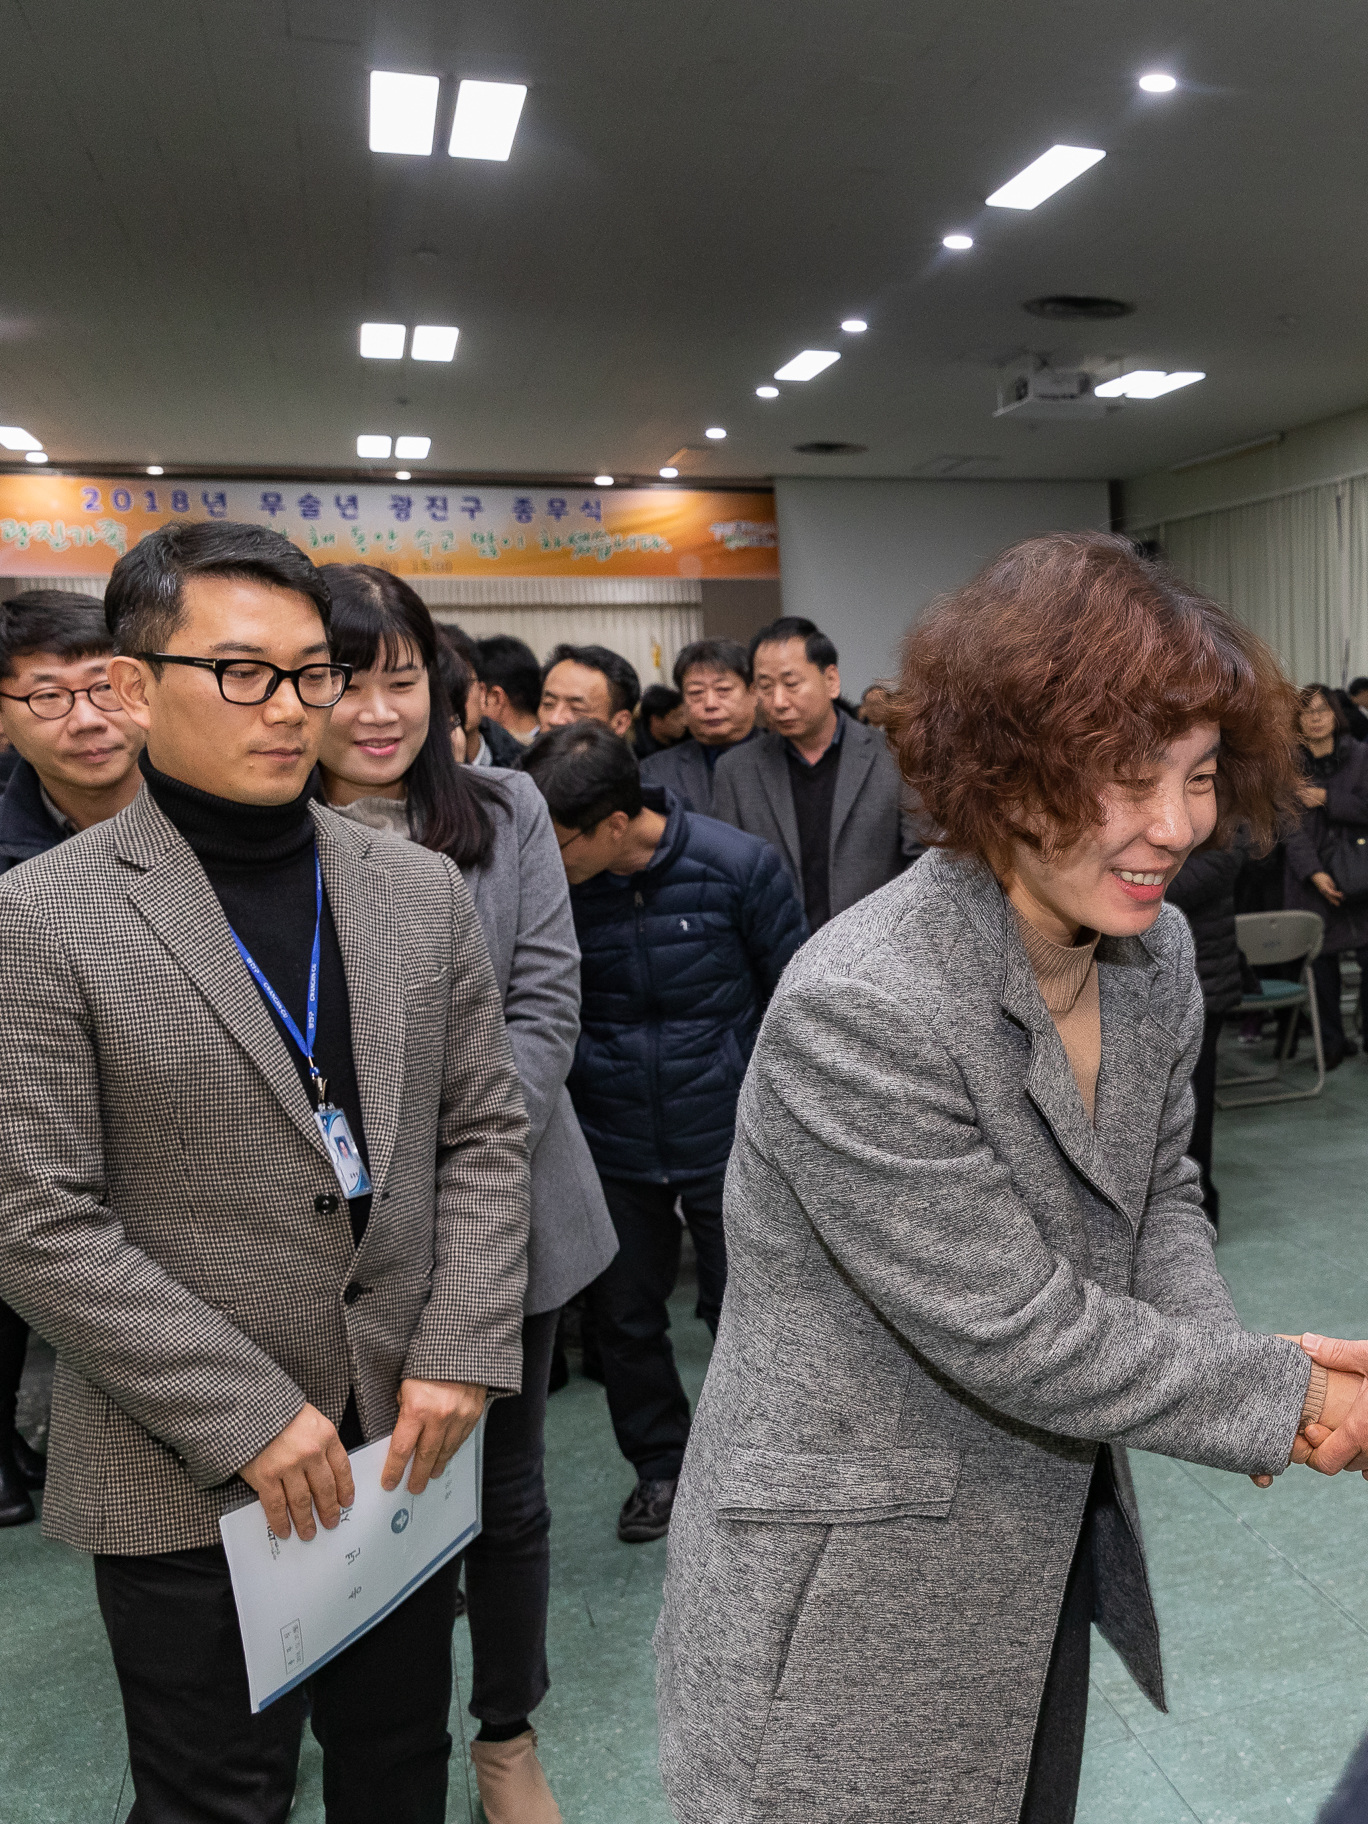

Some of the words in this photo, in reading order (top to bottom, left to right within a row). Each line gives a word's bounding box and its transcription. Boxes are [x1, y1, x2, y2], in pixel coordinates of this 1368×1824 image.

[81, 487, 228, 518] 2018년
[259, 491, 359, 521] 무술년
[389, 494, 484, 522] 광진구
[512, 497, 602, 523] 종무식
[413, 528, 458, 559] 수고
[469, 528, 525, 559] 많이
